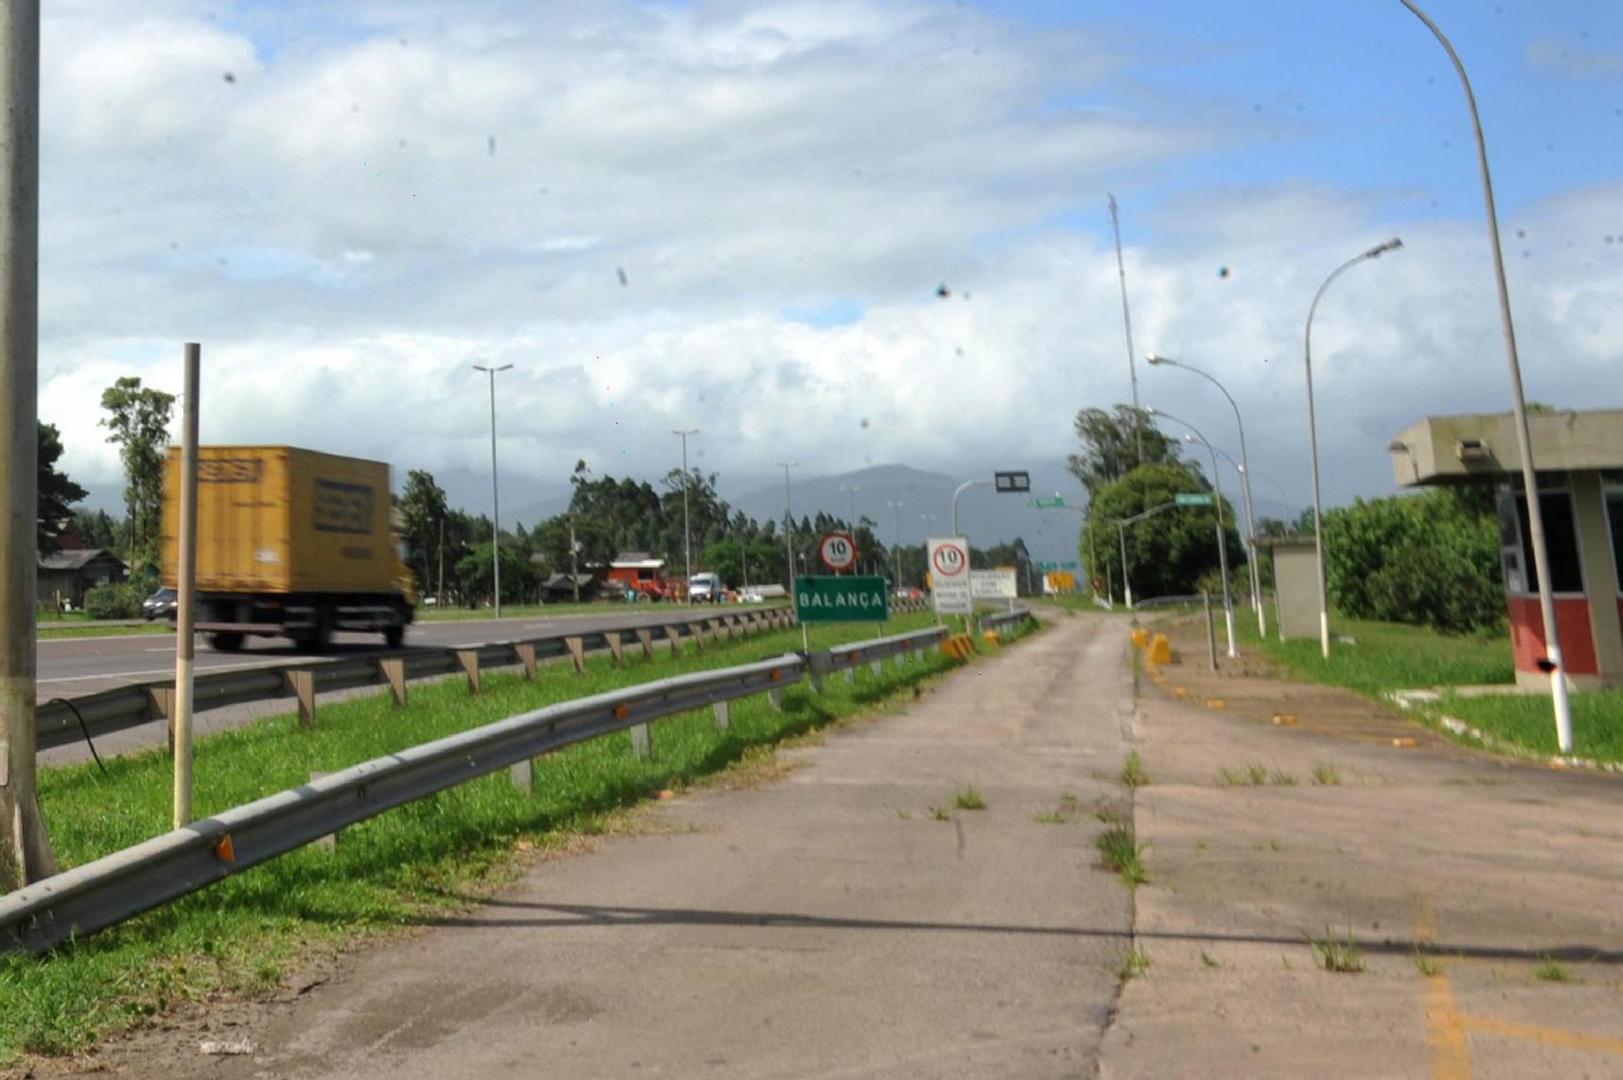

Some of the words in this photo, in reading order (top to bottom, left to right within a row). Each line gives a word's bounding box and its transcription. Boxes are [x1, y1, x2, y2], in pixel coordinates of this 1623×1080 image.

[829, 540, 847, 556] 10
[940, 549, 958, 565] 10
[799, 592, 883, 610] BALANÇA
